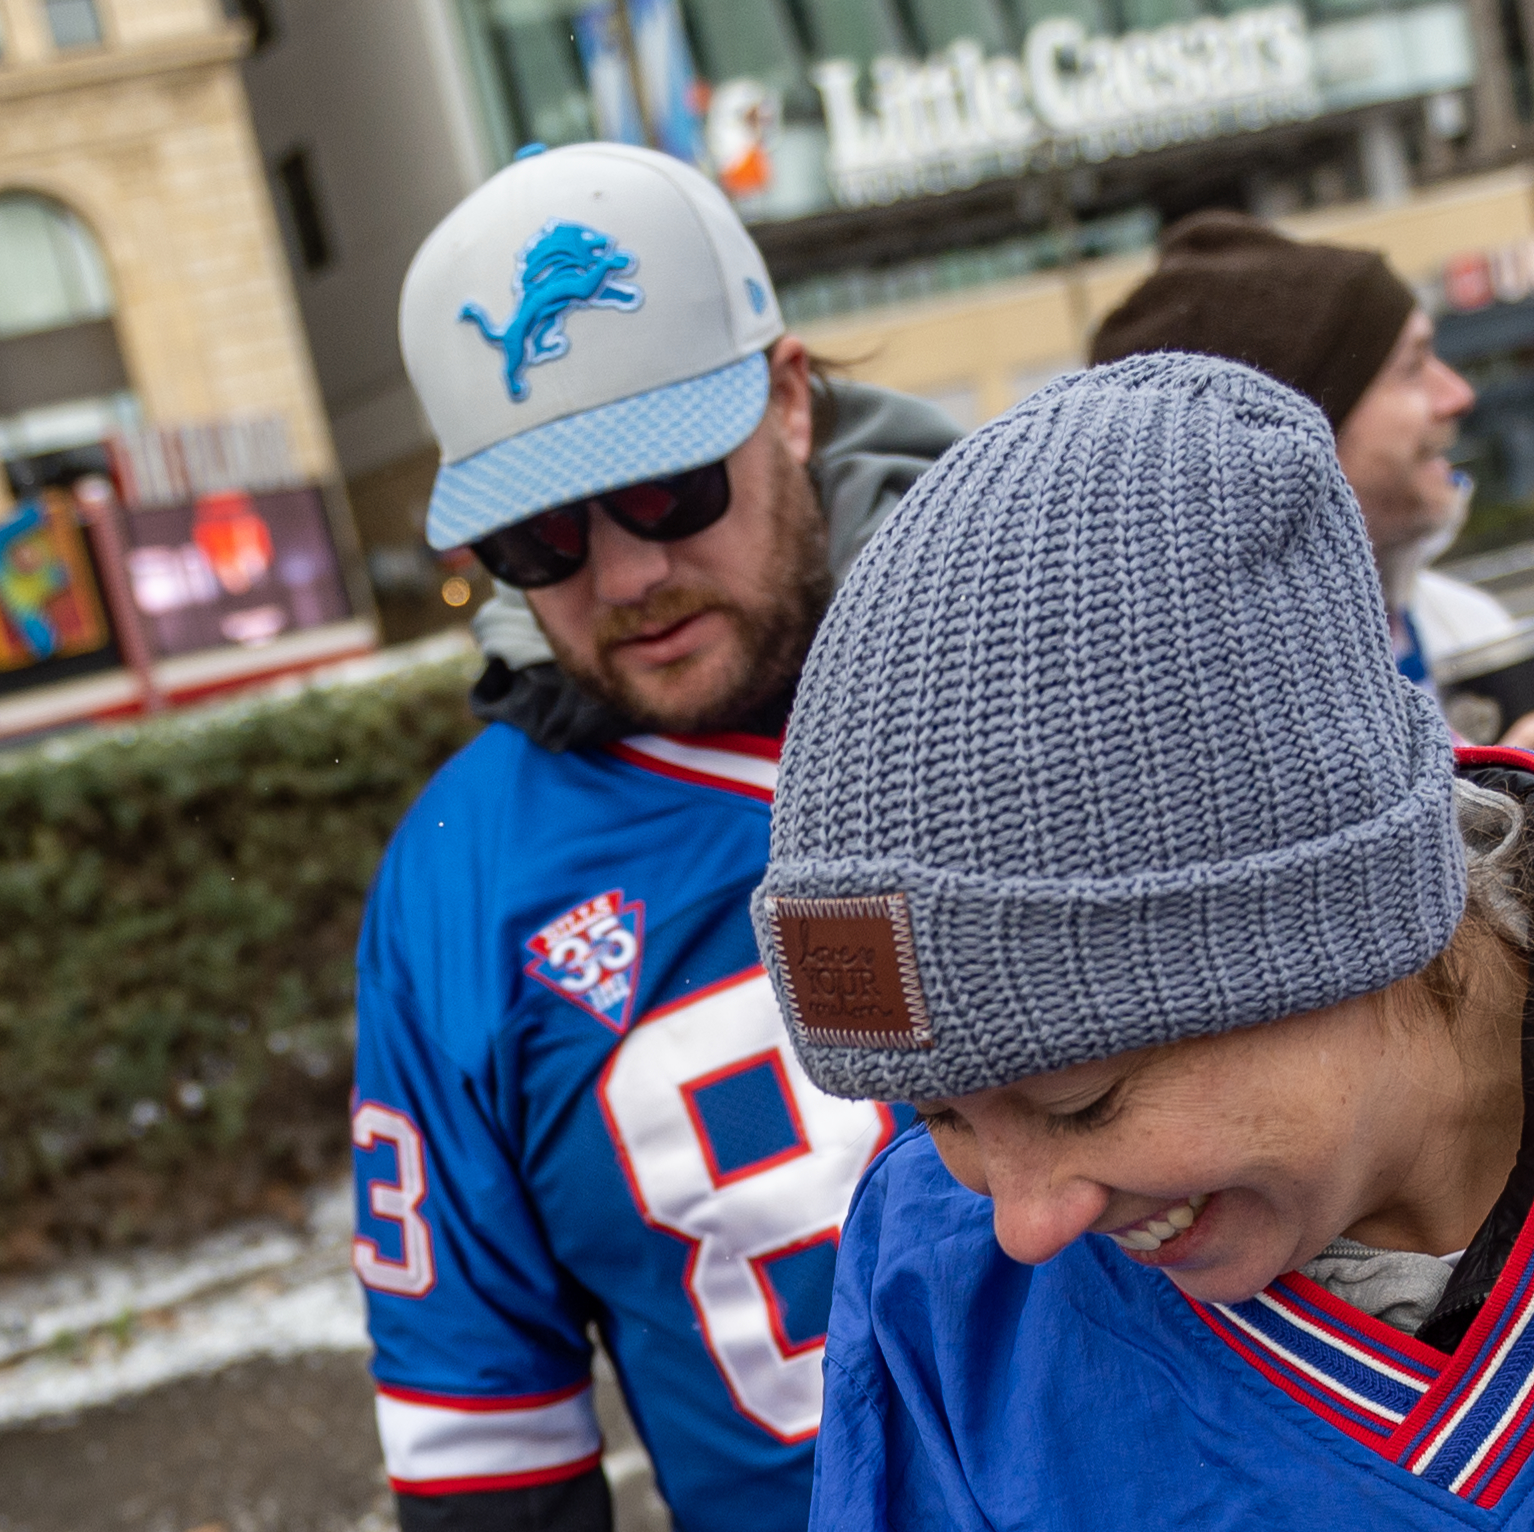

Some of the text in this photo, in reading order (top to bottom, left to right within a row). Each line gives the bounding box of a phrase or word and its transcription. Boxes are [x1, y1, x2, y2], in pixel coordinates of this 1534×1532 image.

[811, 36, 1037, 174] Little
[1025, 4, 1311, 132] Caesars
[549, 916, 637, 992] 35
[352, 1100, 436, 1298] 3
